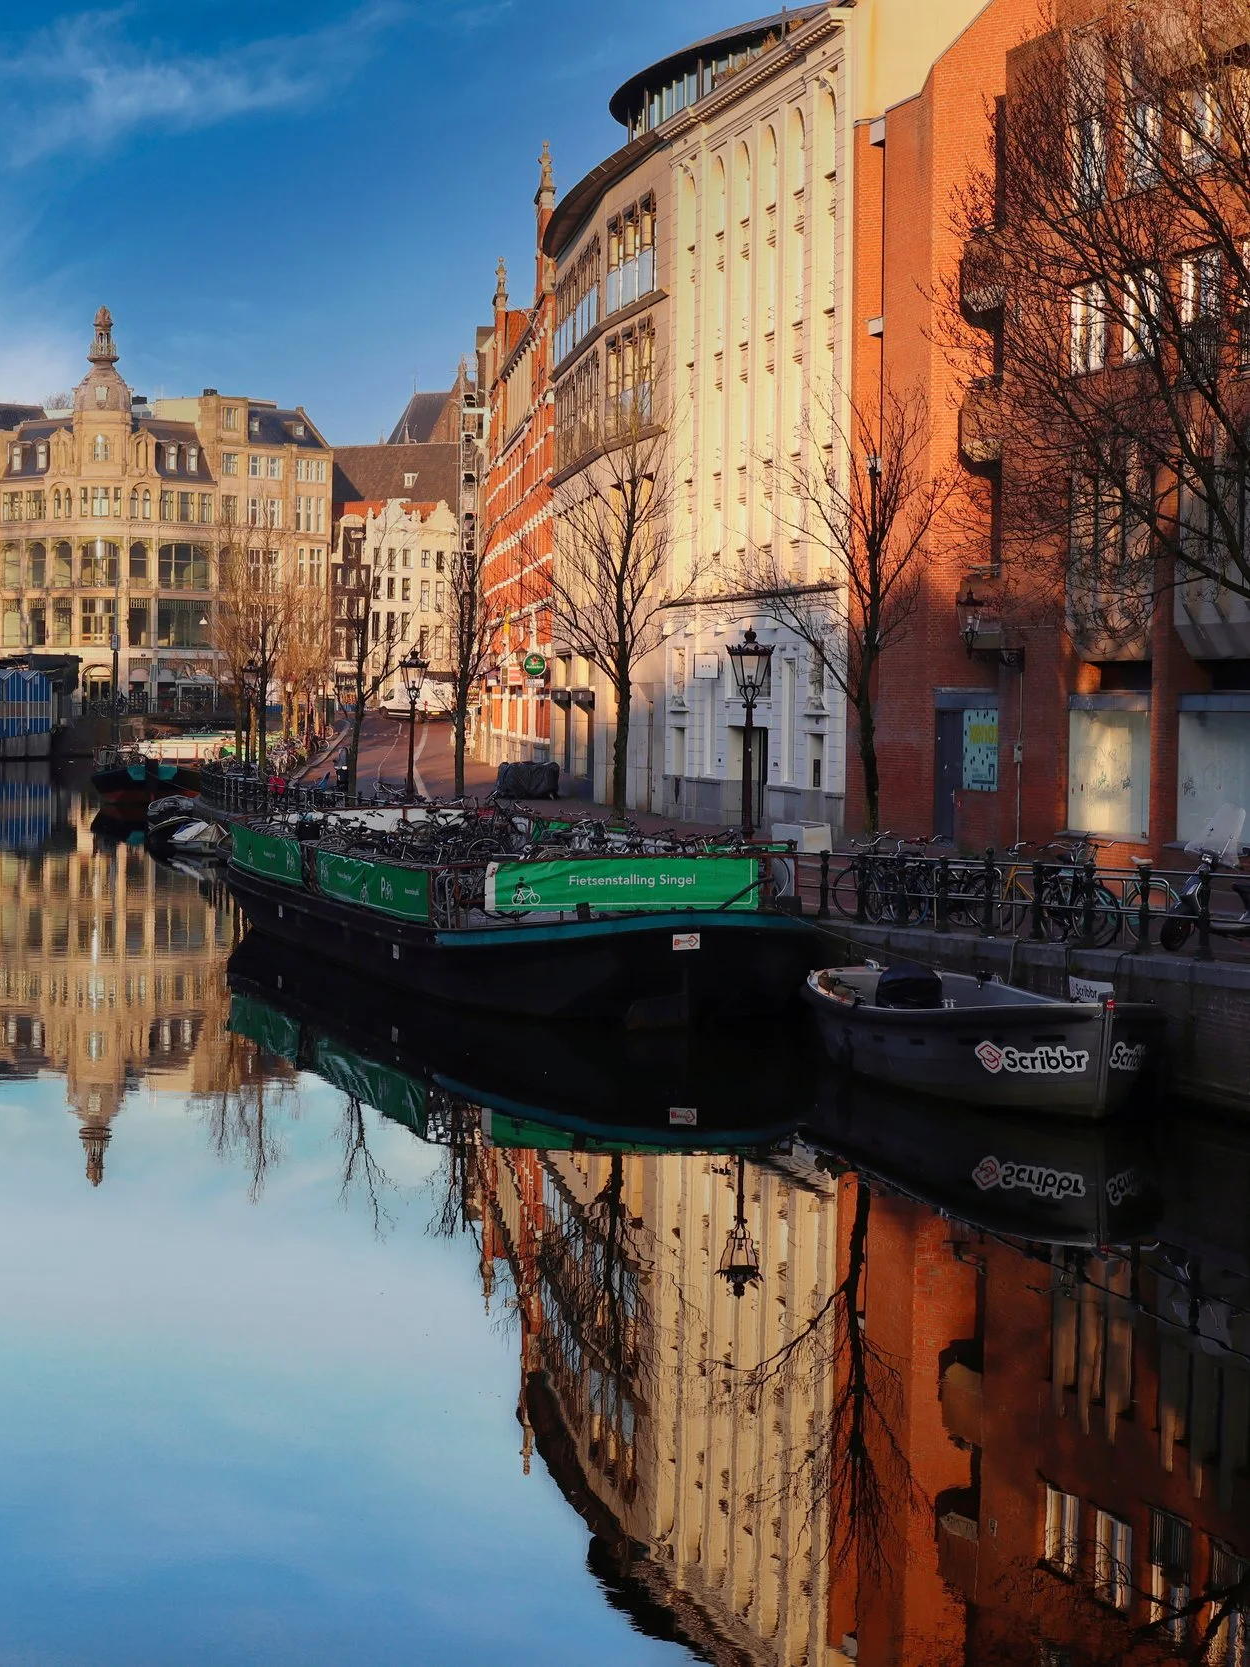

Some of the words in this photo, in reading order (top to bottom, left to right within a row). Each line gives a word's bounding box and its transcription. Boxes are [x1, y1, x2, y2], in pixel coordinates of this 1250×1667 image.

[568, 874, 656, 888] Fietsenstalling
[659, 874, 696, 888] Singel
[1075, 983, 1097, 999] Scribbr
[1005, 1050, 1086, 1070] Scribbr
